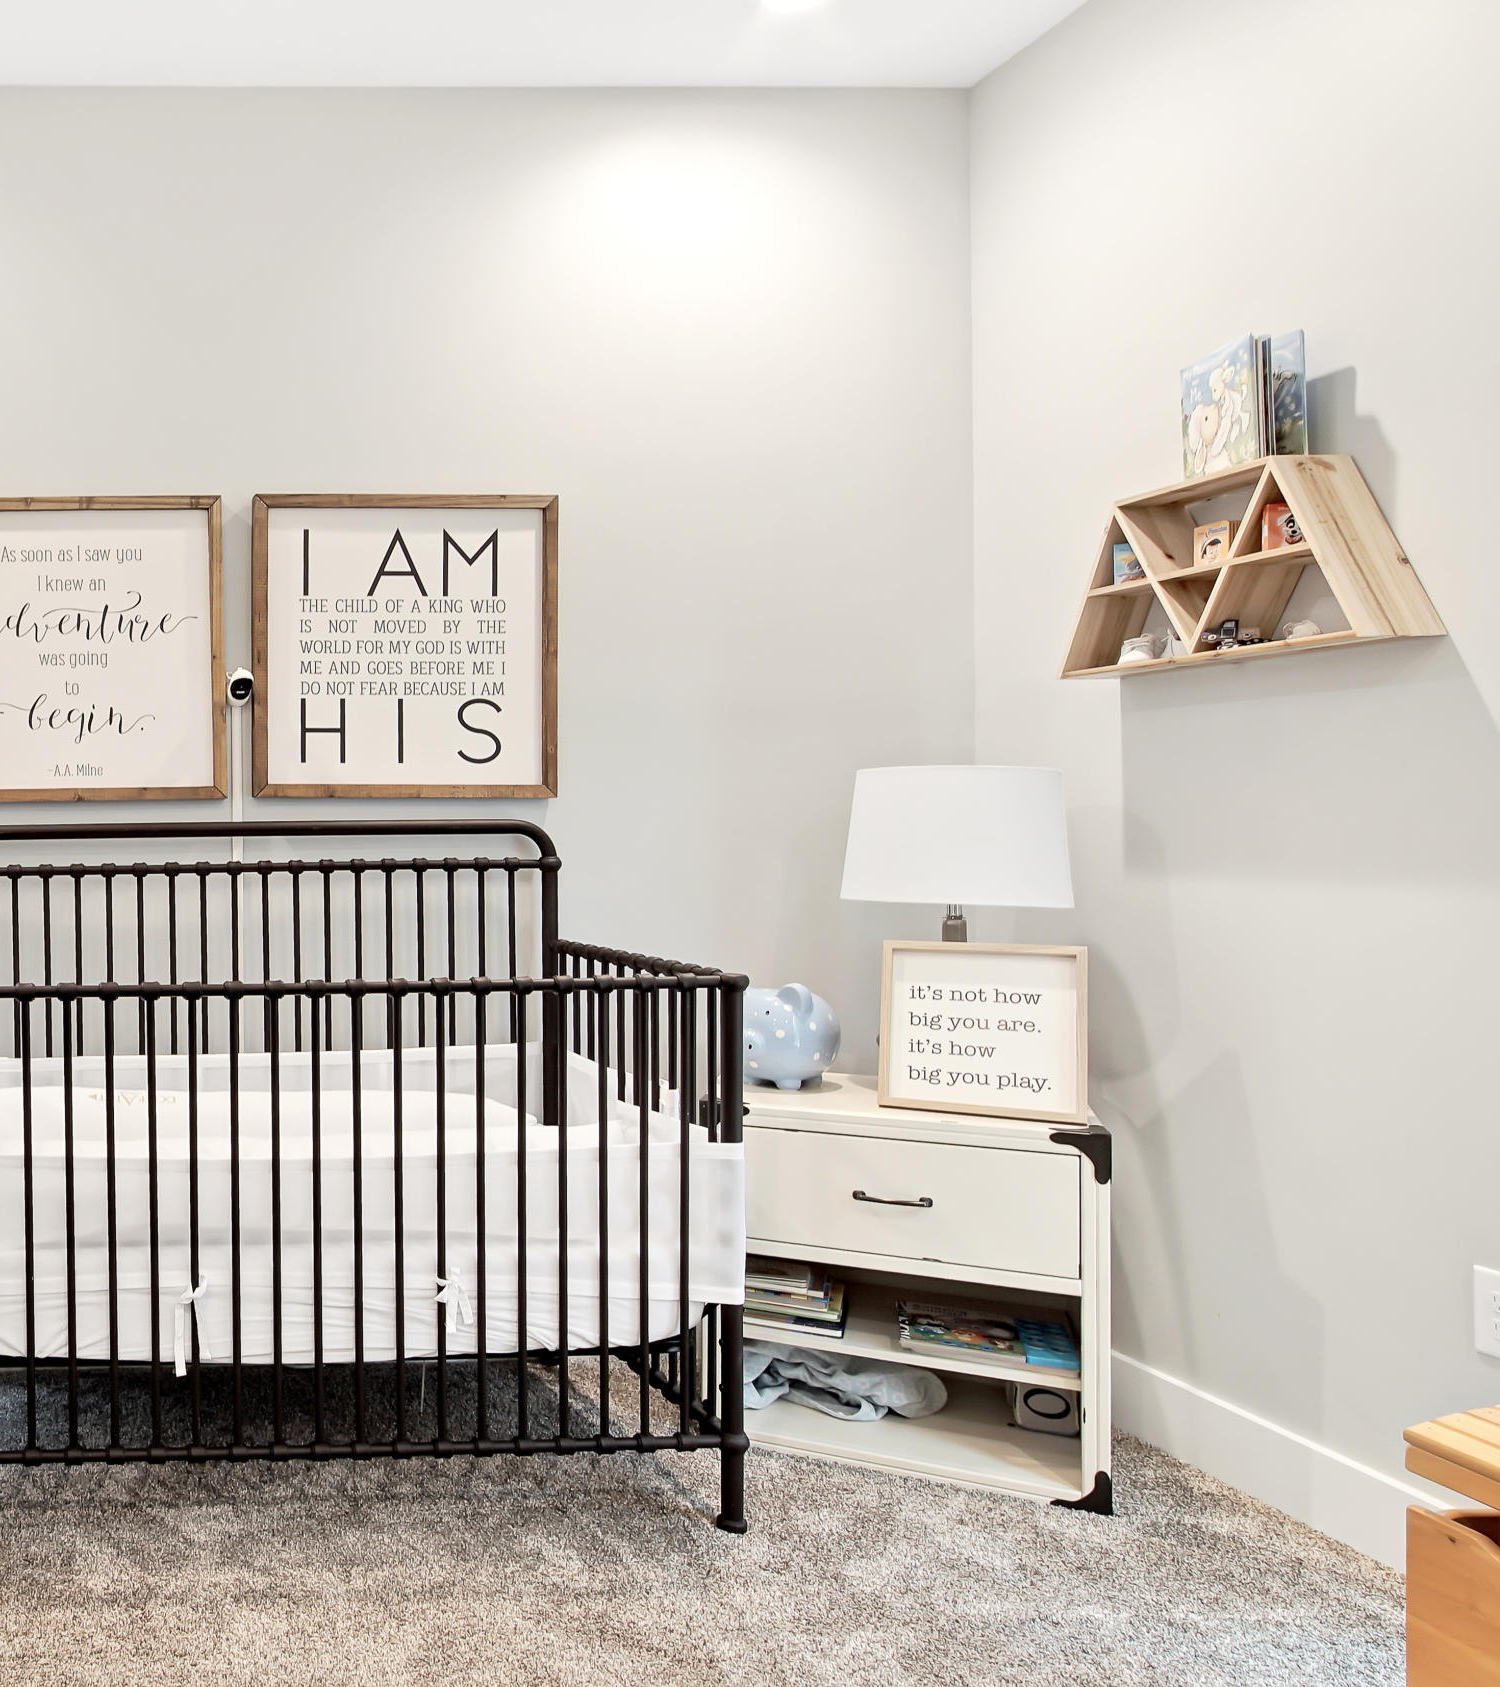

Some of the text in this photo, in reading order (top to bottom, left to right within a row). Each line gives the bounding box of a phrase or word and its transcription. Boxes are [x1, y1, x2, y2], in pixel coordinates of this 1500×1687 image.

[0, 545, 142, 564] As soon as I saw you
[303, 528, 498, 596] I AM
[37, 575, 106, 592] I knew an
[299, 599, 506, 613] THE CHILD OF A KING WHO
[299, 620, 506, 634] IS NOT MOVED BY THE
[299, 640, 505, 655] WORLD FOR MY GOD IS WITH
[39, 652, 108, 668] was going
[300, 661, 505, 675] ME AND GOES BEFORE ME I
[65, 681, 80, 696] to
[301, 681, 505, 696] DO NOT FEAR BECAUSE I AM
[76, 764, 103, 777] Milne
[949, 988, 987, 1002] not
[993, 989, 1042, 1005] how
[909, 1011, 1041, 1033] big you are.
[949, 1041, 996, 1058] how
[908, 1065, 1051, 1093] big you play.
